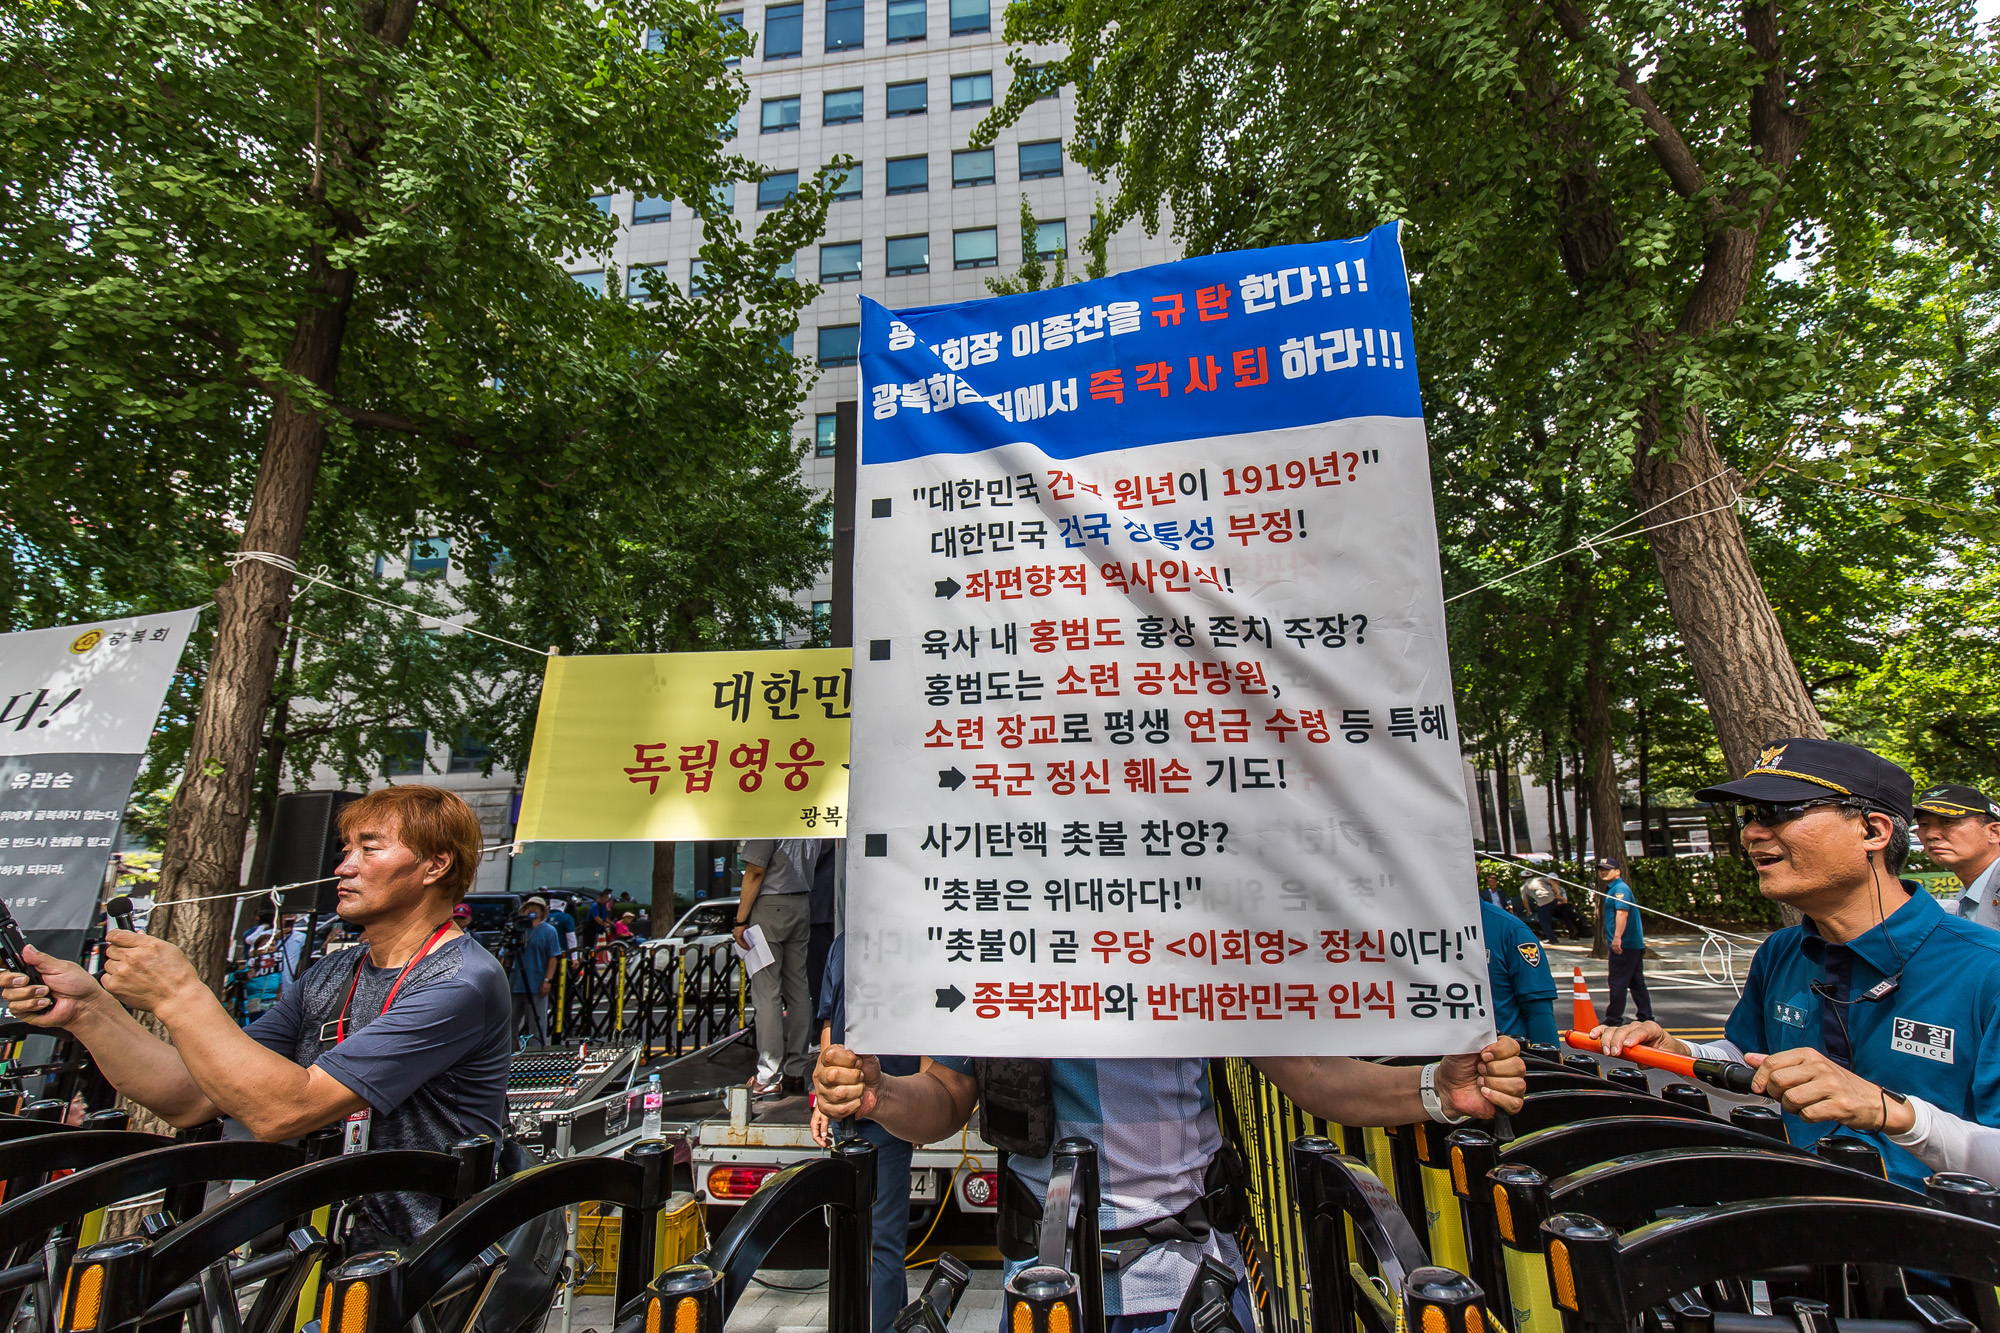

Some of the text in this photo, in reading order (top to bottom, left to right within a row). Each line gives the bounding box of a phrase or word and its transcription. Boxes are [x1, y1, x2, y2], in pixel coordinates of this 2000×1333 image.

[889, 321, 1002, 371] 광회장
[1012, 302, 1141, 357] 이종찬을
[1239, 258, 1367, 314] 한다!!!
[1280, 328, 1403, 379] 하라!!!
[914, 473, 1040, 511] "대한민국
[1114, 469, 1207, 510] 원년이
[1223, 450, 1378, 495] 1919년?"
[932, 509, 1307, 557] 대한민국 건국 정통성 부정!
[966, 560, 1233, 602] 좌편향적 역사인식!
[922, 614, 1367, 659] 육사 내 홍범도 흉상 존치 주장?
[925, 661, 1280, 706] 홍범도는 소련 공산당원,
[925, 705, 1448, 749] 소련 장교로 평생 연금 수령 등 특혜
[11, 771, 74, 789] 유관순
[624, 738, 825, 795] 독립영웅
[972, 757, 1286, 796] 국군 정신 훼손 기도!
[34, 810, 81, 821] 굴복하지
[800, 806, 848, 828] 광복
[12, 837, 47, 848] 반드시
[87, 837, 111, 847] 받고
[921, 820, 1228, 857] 사기탄핵 촛불 찬양?
[0, 864, 65, 876] 하게 되리라.
[925, 877, 1201, 912] "촛불은 위대하다!"
[929, 927, 1035, 962] "촛불이
[1050, 931, 1078, 963] 곧
[1091, 930, 1154, 964] 우당
[1167, 930, 1307, 965] <이회영>
[1321, 926, 1478, 964] 정신이다!"
[973, 981, 1485, 1021] 종북좌파와 반대한민국 인식 공유!
[1896, 1041, 1947, 1059] POLICE
